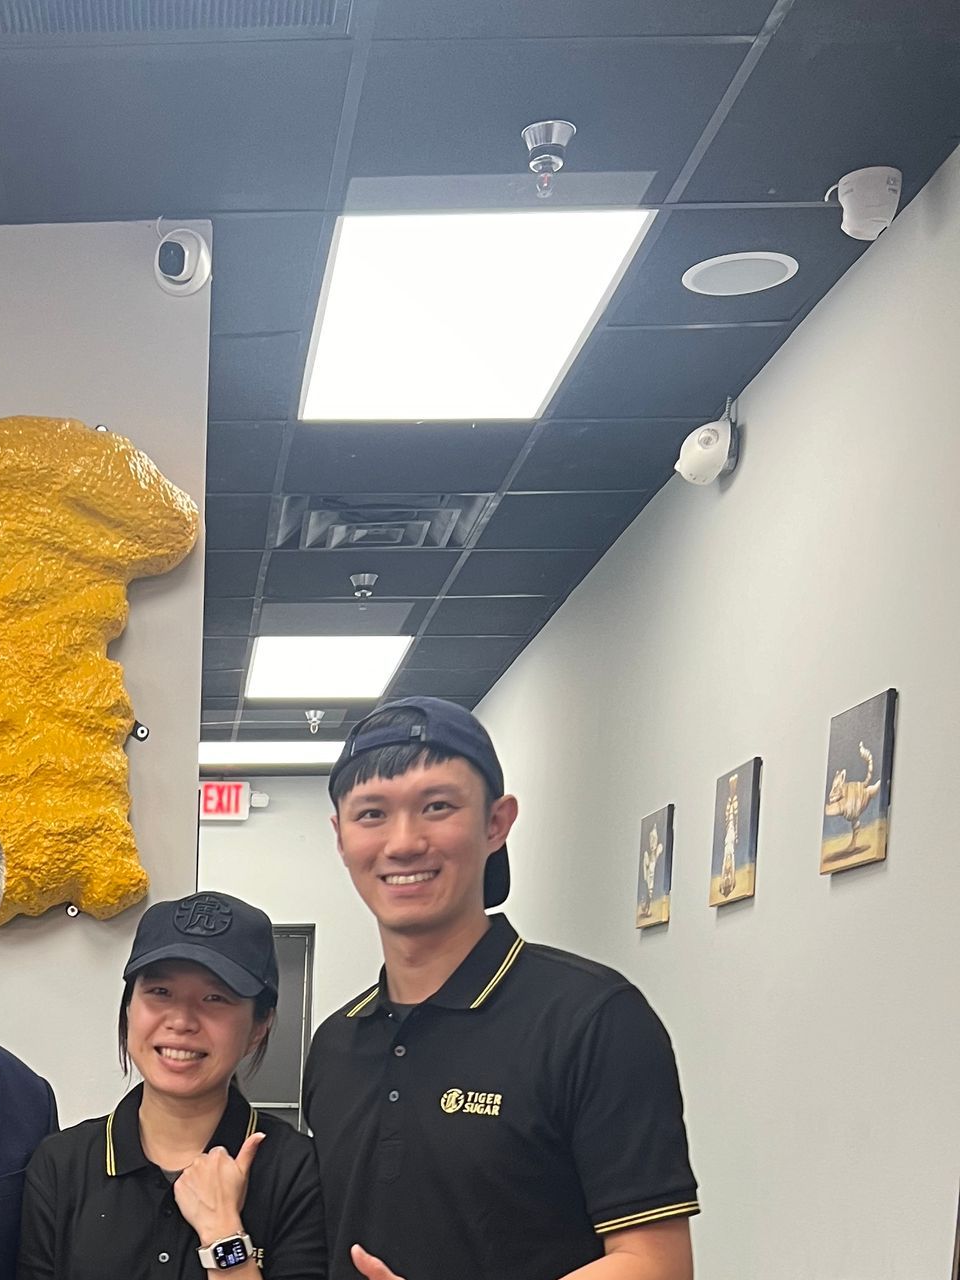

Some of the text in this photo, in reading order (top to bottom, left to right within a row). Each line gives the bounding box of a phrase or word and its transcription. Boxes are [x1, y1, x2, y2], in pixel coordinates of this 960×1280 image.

[203, 784, 243, 814] EXIT
[466, 1091, 503, 1105] TIGER
[462, 1102, 500, 1116] SUGAR
